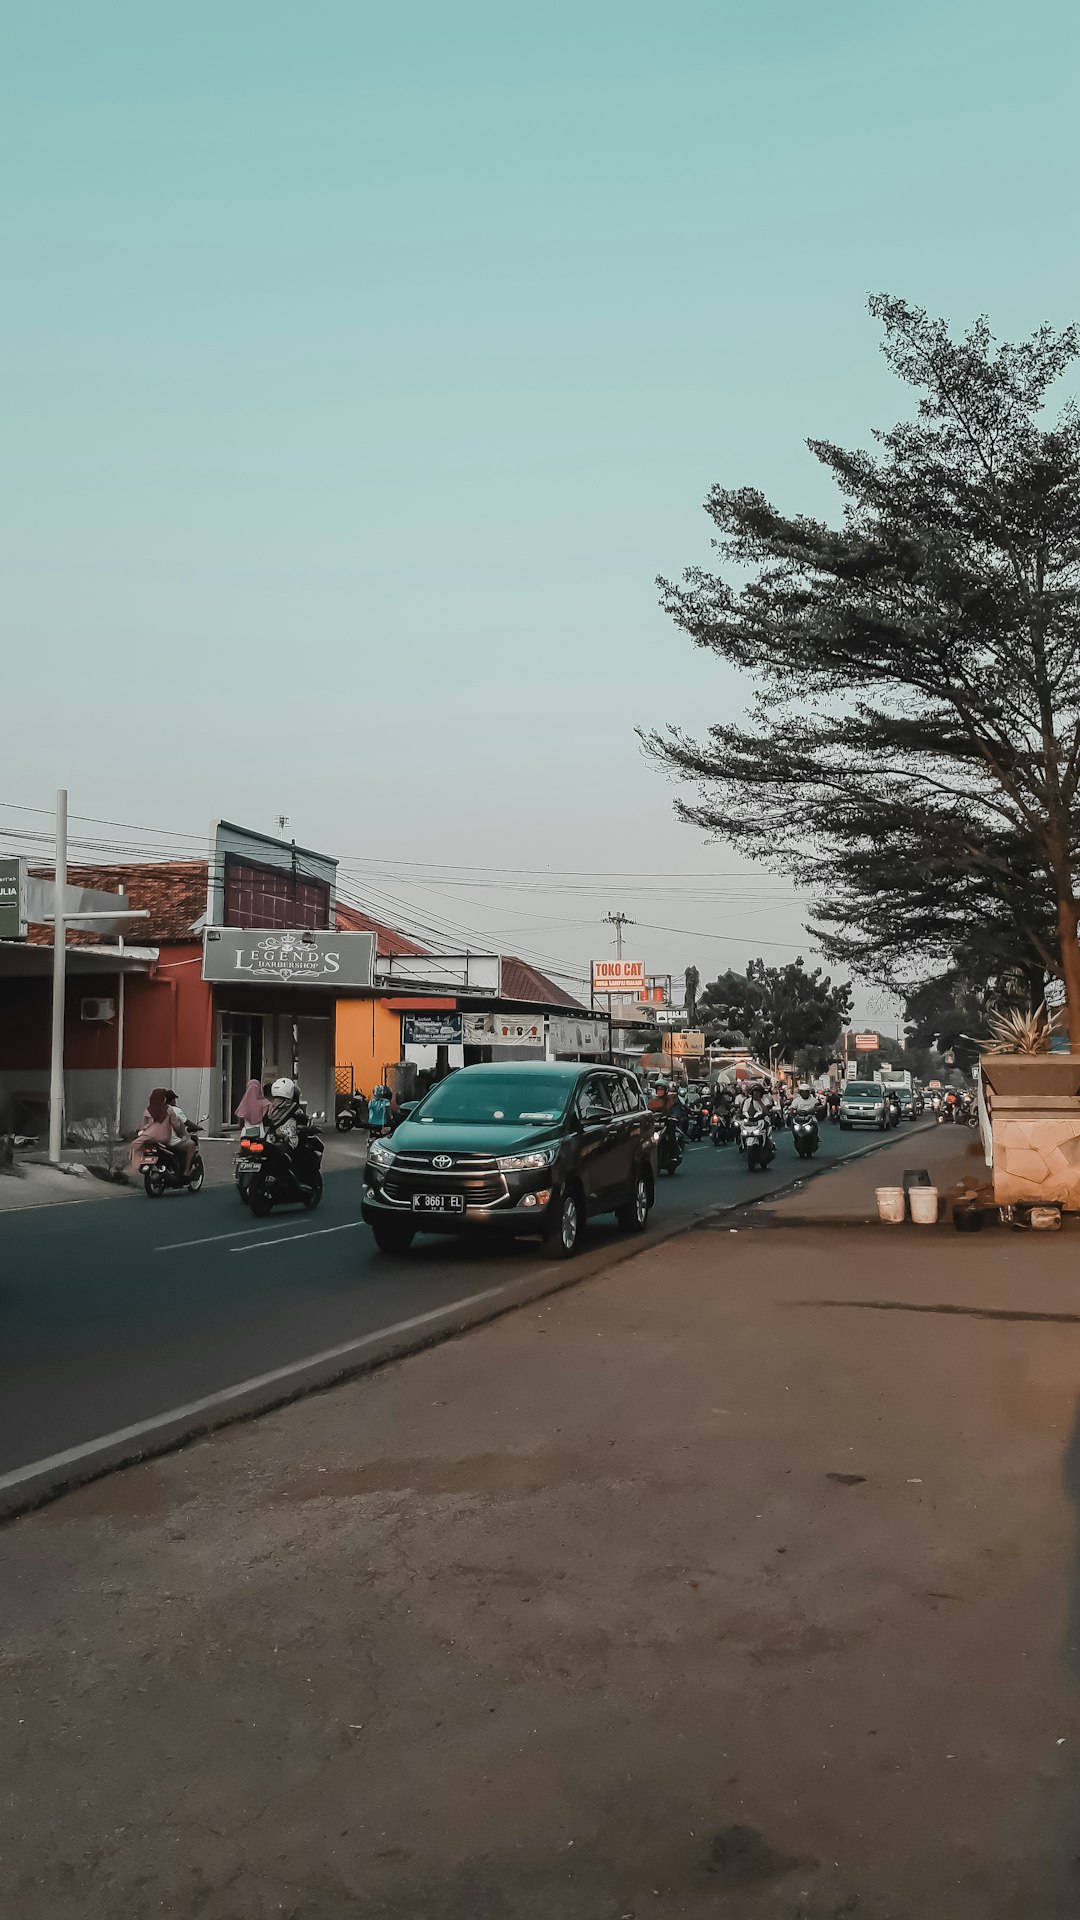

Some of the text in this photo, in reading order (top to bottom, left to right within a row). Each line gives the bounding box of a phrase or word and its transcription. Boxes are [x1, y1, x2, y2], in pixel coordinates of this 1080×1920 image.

[234, 949, 340, 973] LEGEND'S
[258, 960, 319, 969] BARBERSHOP
[596, 962, 642, 976] TOKO CAT
[414, 1195, 421, 1206] K
[450, 1196, 461, 1206] EL
